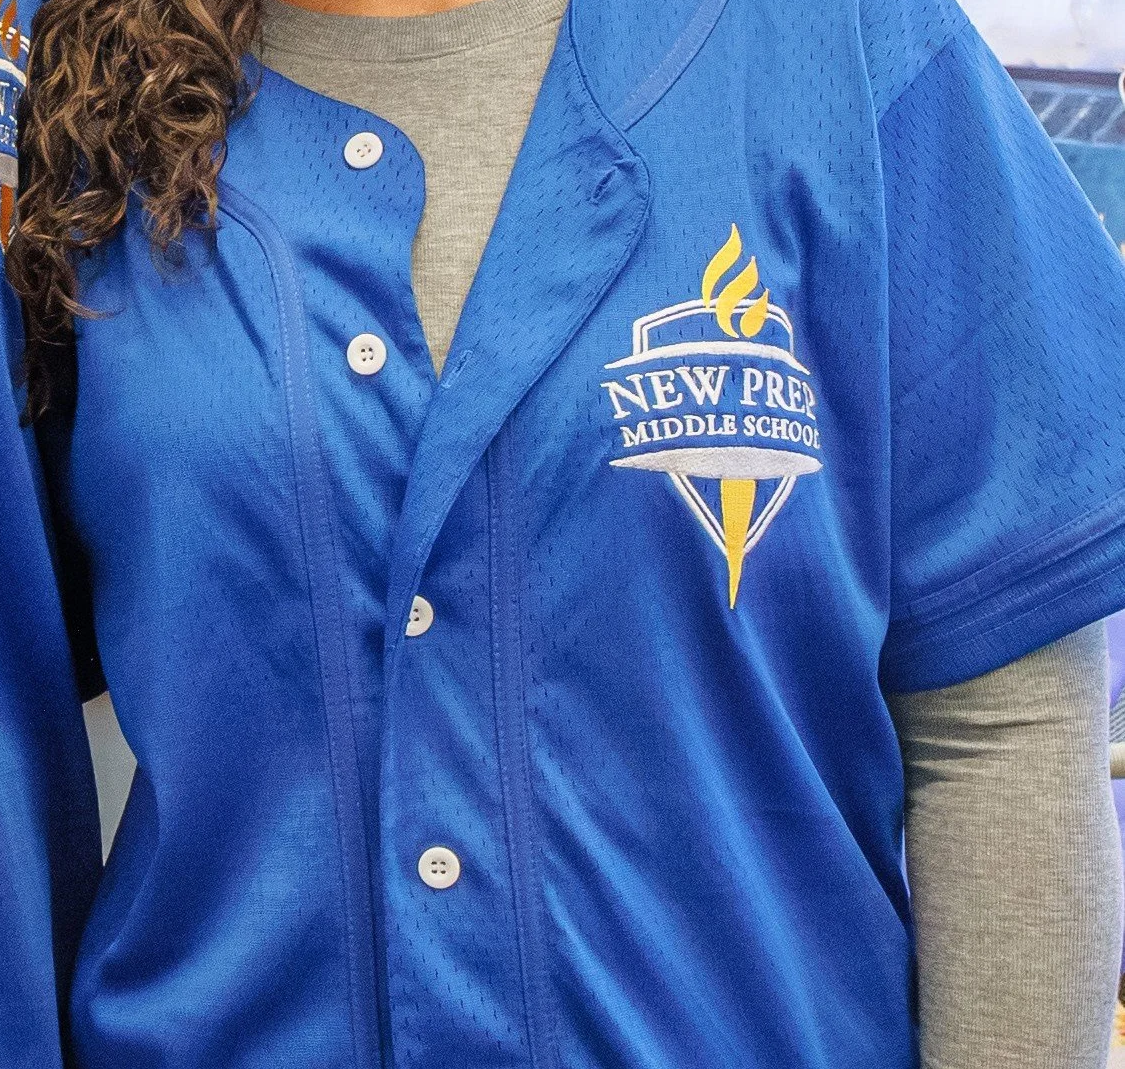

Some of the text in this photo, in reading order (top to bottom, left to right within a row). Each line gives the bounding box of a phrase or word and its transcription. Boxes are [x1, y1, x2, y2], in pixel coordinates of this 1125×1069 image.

[600, 366, 816, 421] NEW PREP
[620, 414, 820, 449] MIDDLE SCHOOL
